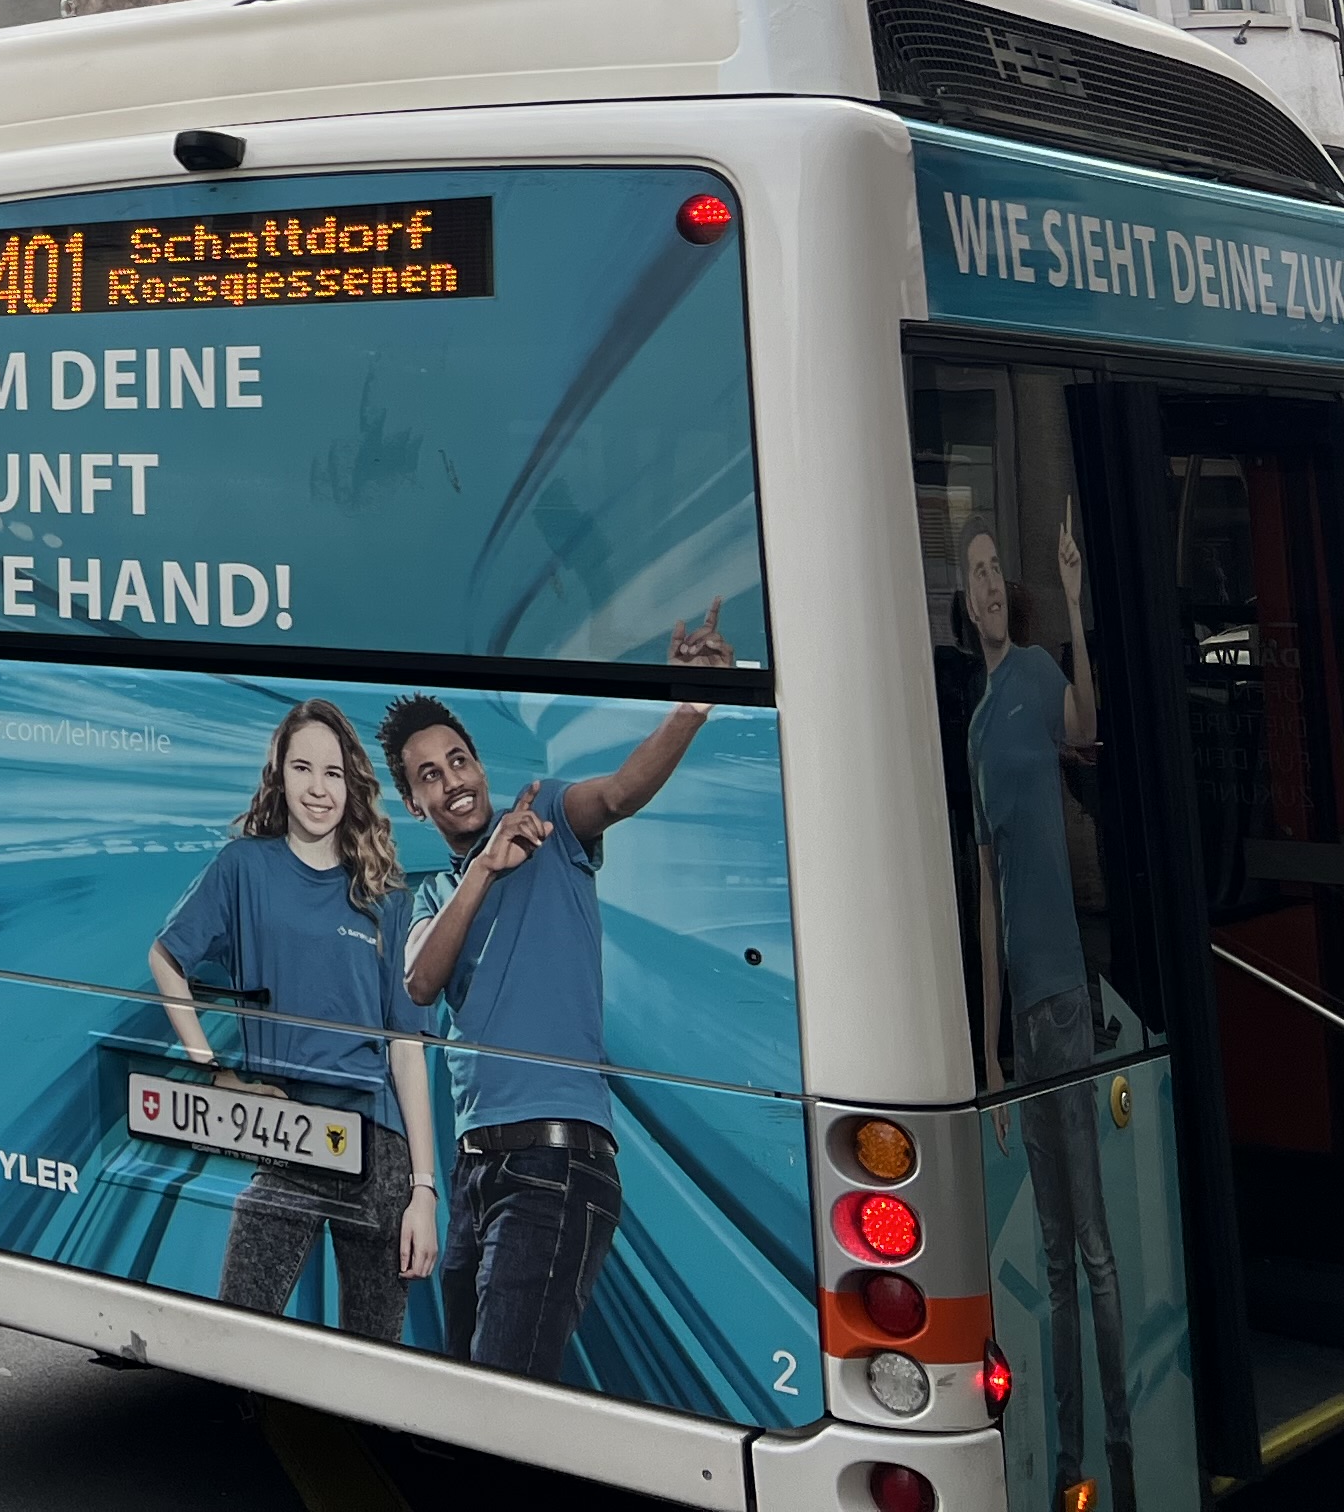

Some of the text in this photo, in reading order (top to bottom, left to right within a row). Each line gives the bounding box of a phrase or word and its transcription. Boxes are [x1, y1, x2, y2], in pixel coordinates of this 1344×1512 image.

[129, 209, 433, 265] Schattdorf
[943, 191, 1036, 284] WIE
[1042, 208, 1156, 300] SIEHT
[1165, 229, 1278, 317] DEINE
[50, 344, 263, 411] DEINE
[57, 556, 294, 631] HAND!
[772, 1349, 800, 1397] 2
